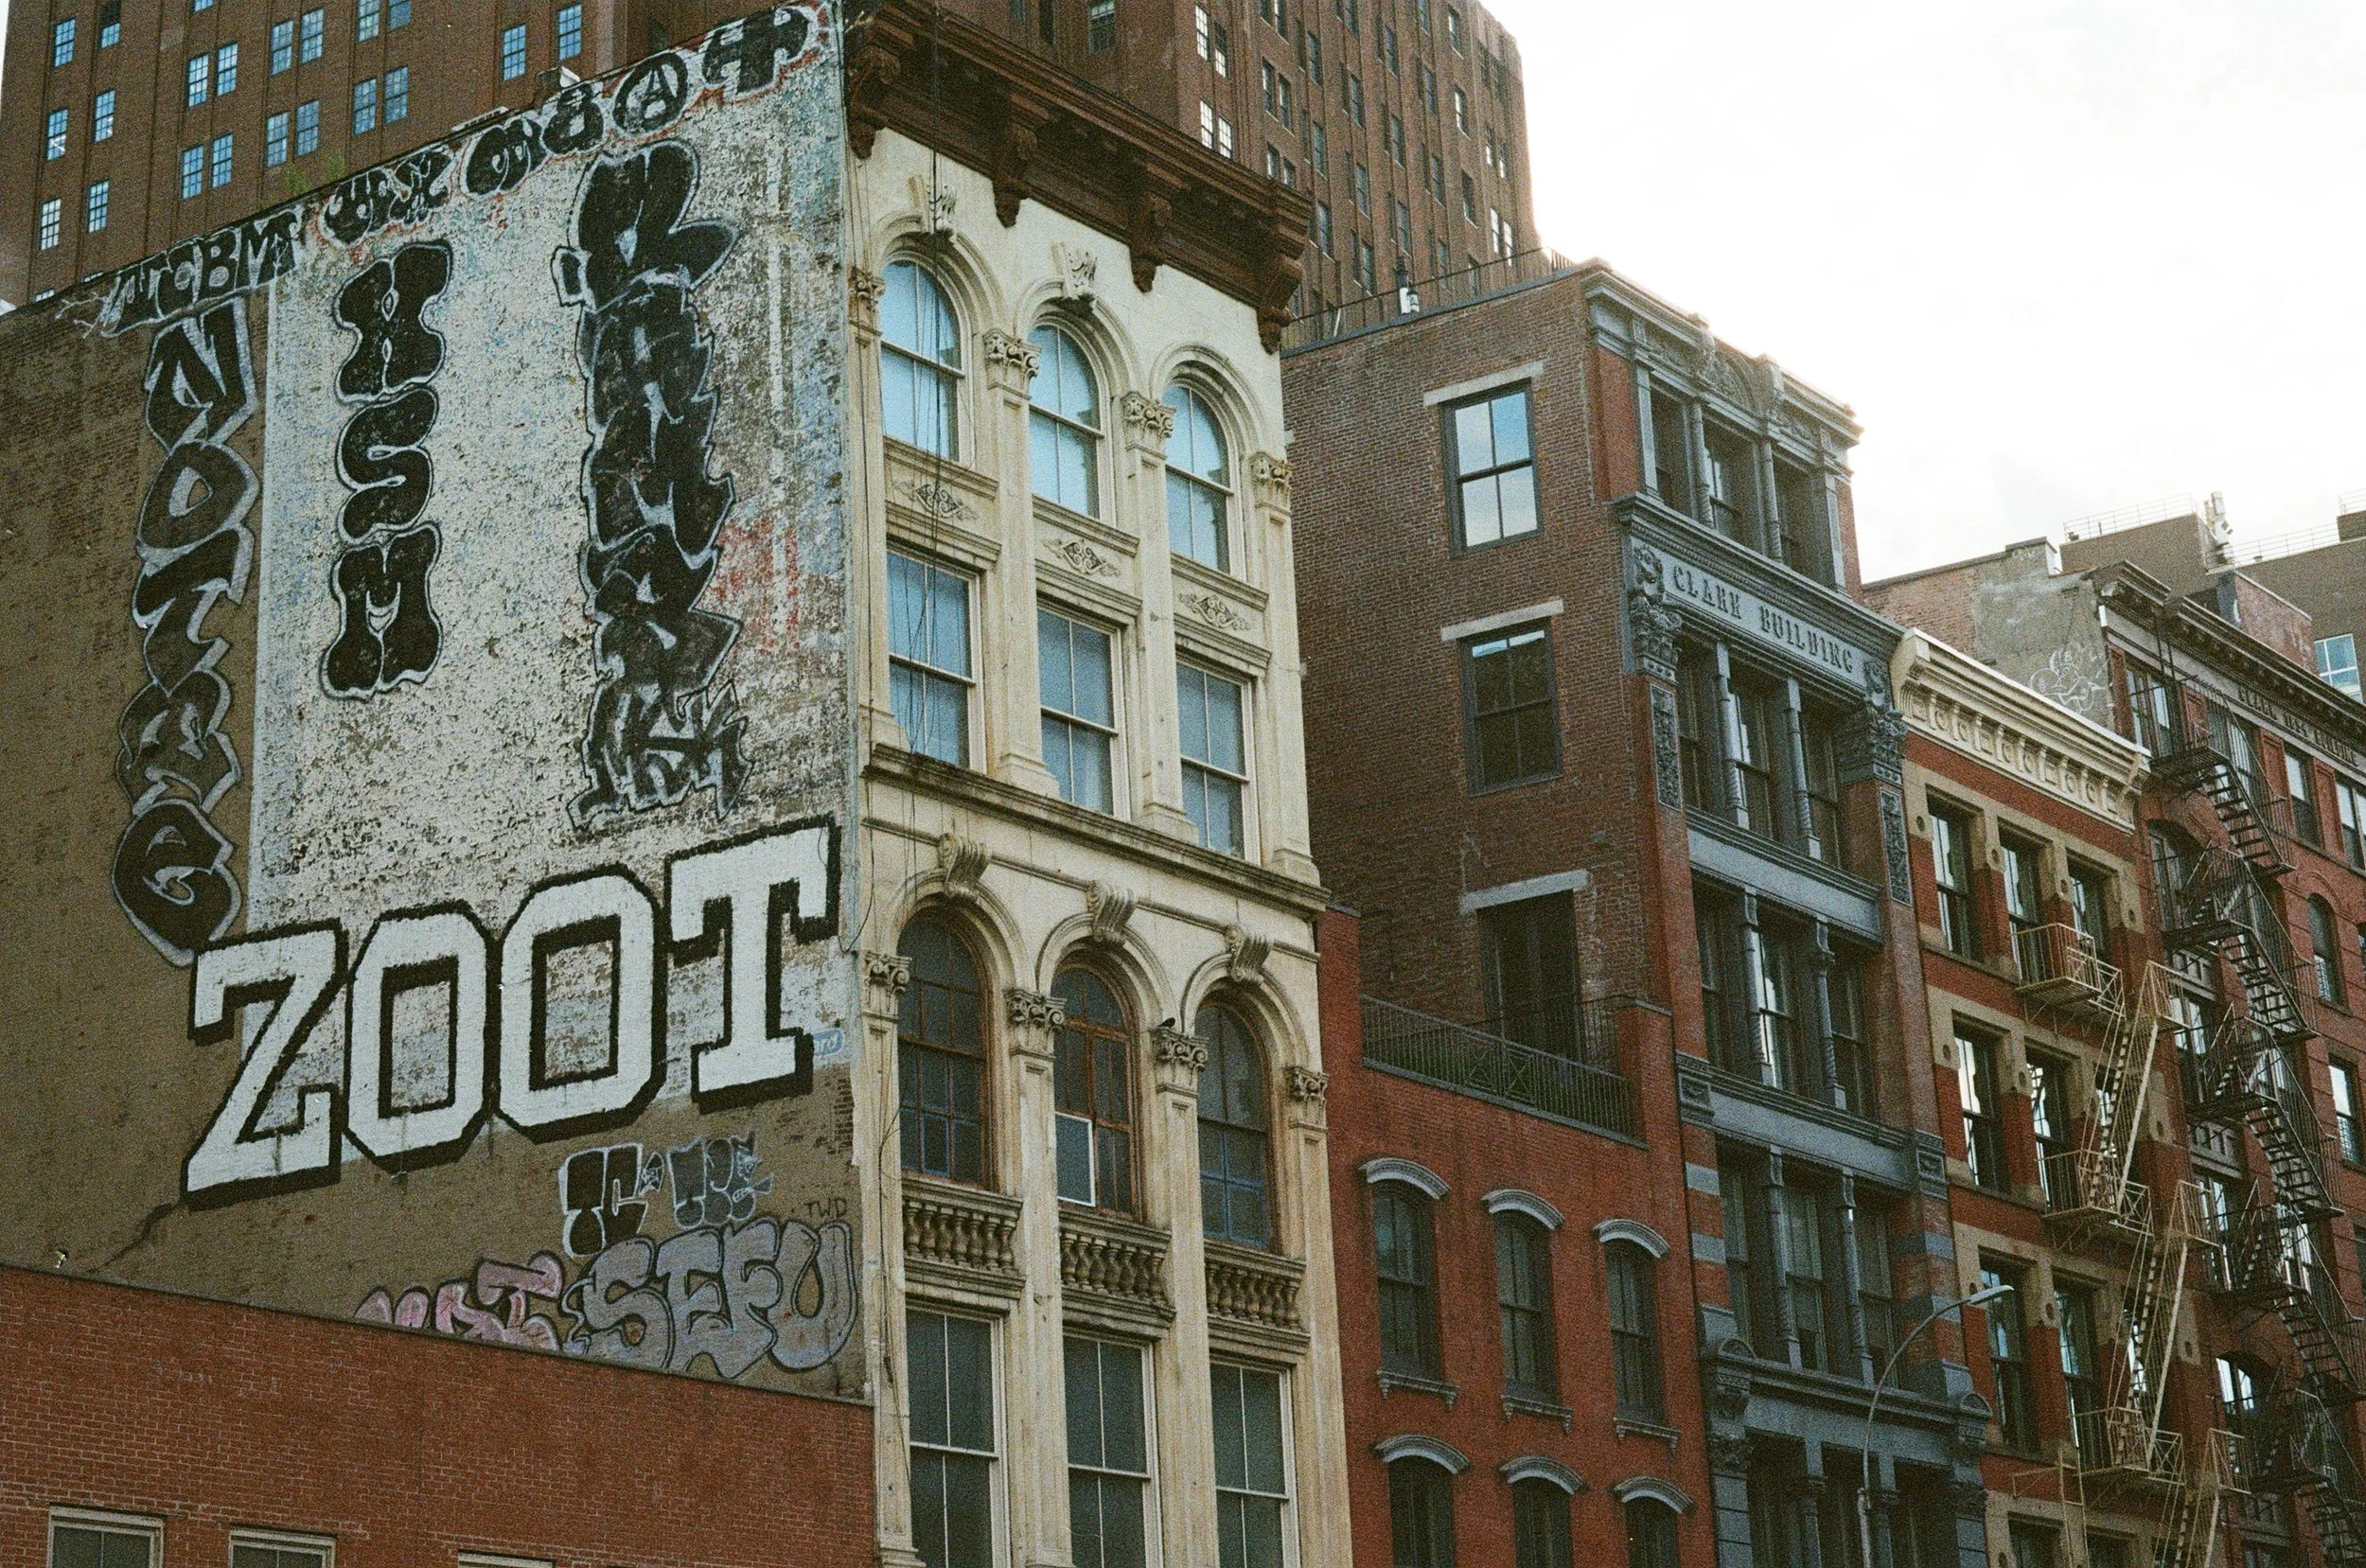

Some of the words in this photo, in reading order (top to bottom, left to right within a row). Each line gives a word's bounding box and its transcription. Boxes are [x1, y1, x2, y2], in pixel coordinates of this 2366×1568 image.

[1672, 565, 1742, 620] CLARK
[1759, 606, 1853, 673] BUILDING
[180, 815, 842, 1211] ZOOT
[803, 1196, 847, 1219] TWD
